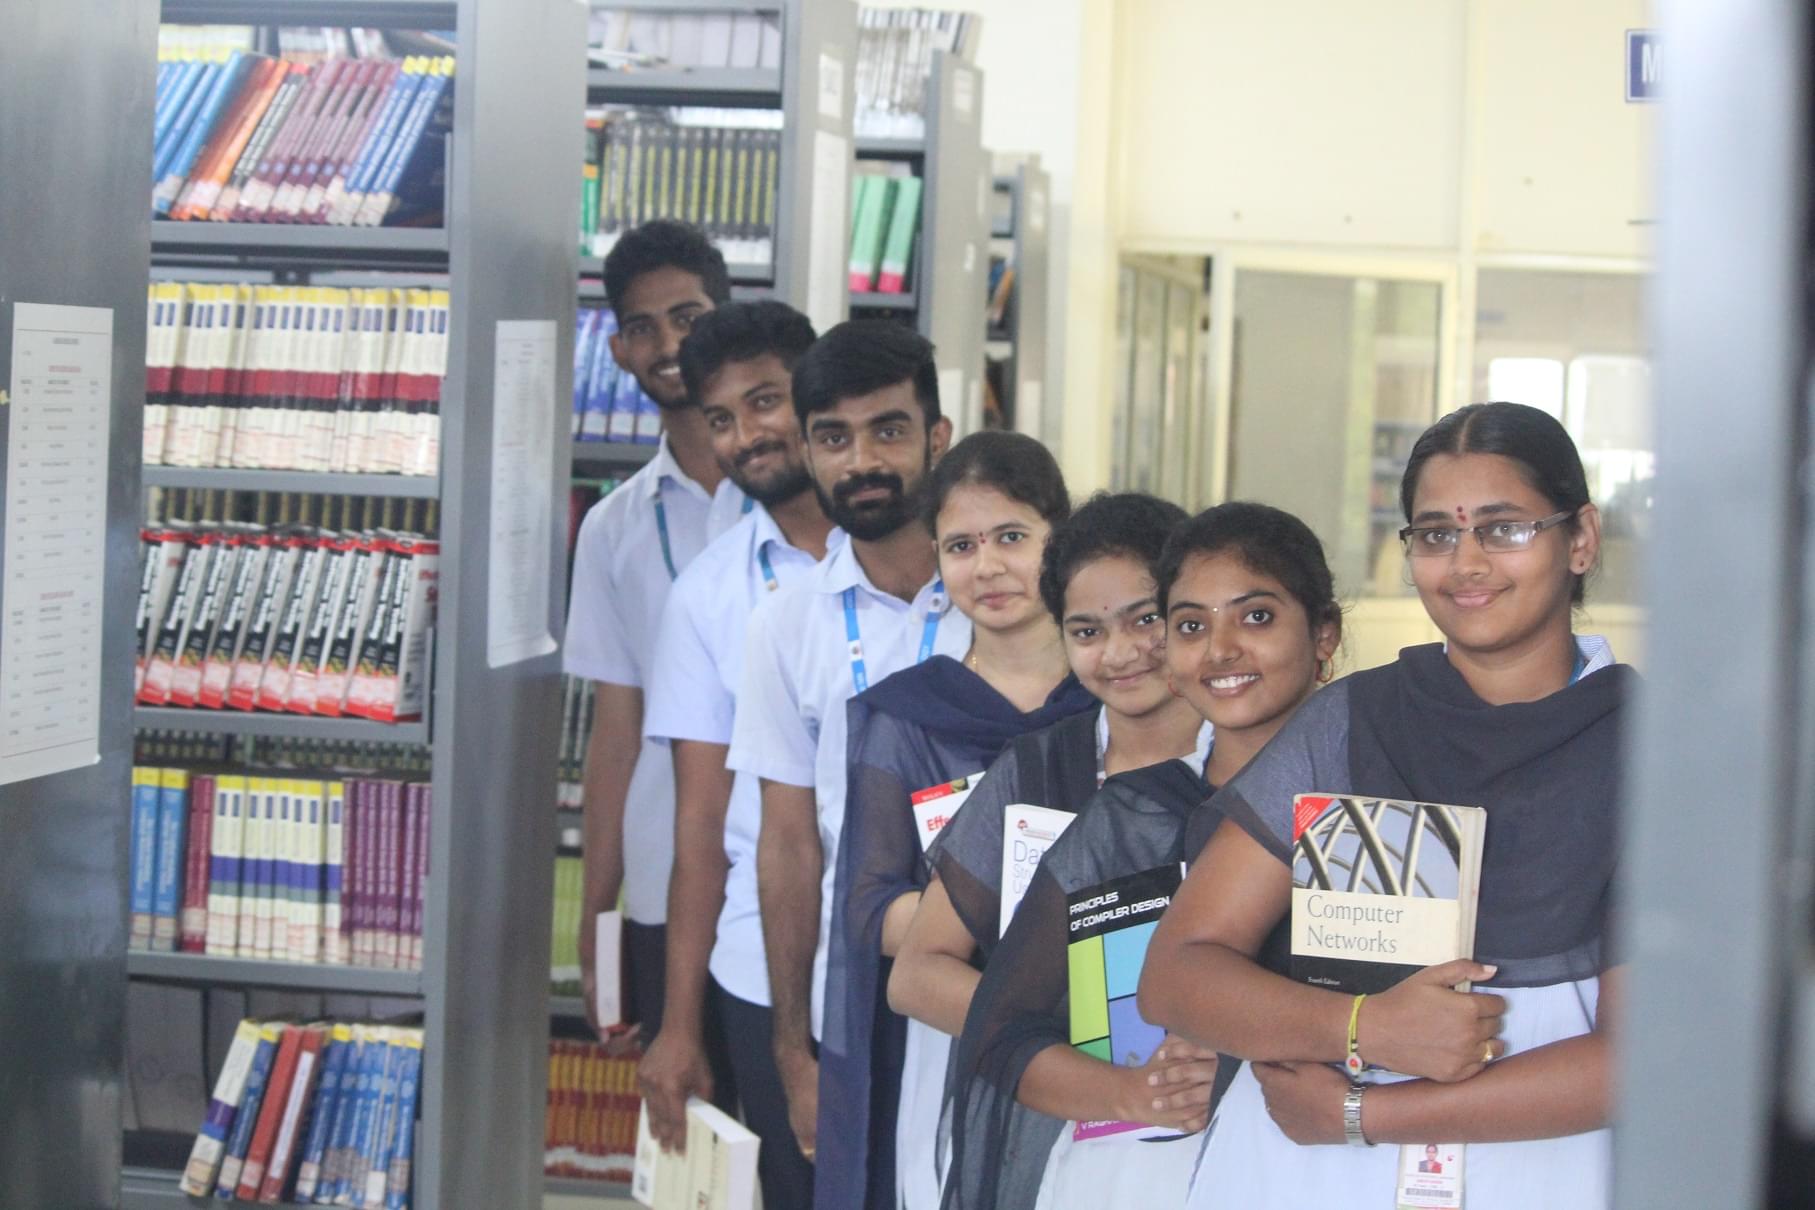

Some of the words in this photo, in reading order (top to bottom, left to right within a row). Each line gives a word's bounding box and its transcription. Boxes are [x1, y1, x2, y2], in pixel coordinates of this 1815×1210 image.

[1069, 891, 1119, 916] PRINCIPLES
[1070, 919, 1081, 932] OF
[1082, 905, 1130, 927] COMPILER
[1131, 896, 1170, 914] DESIGN
[1307, 894, 1404, 926] Computer
[1307, 924, 1397, 954] Networks
